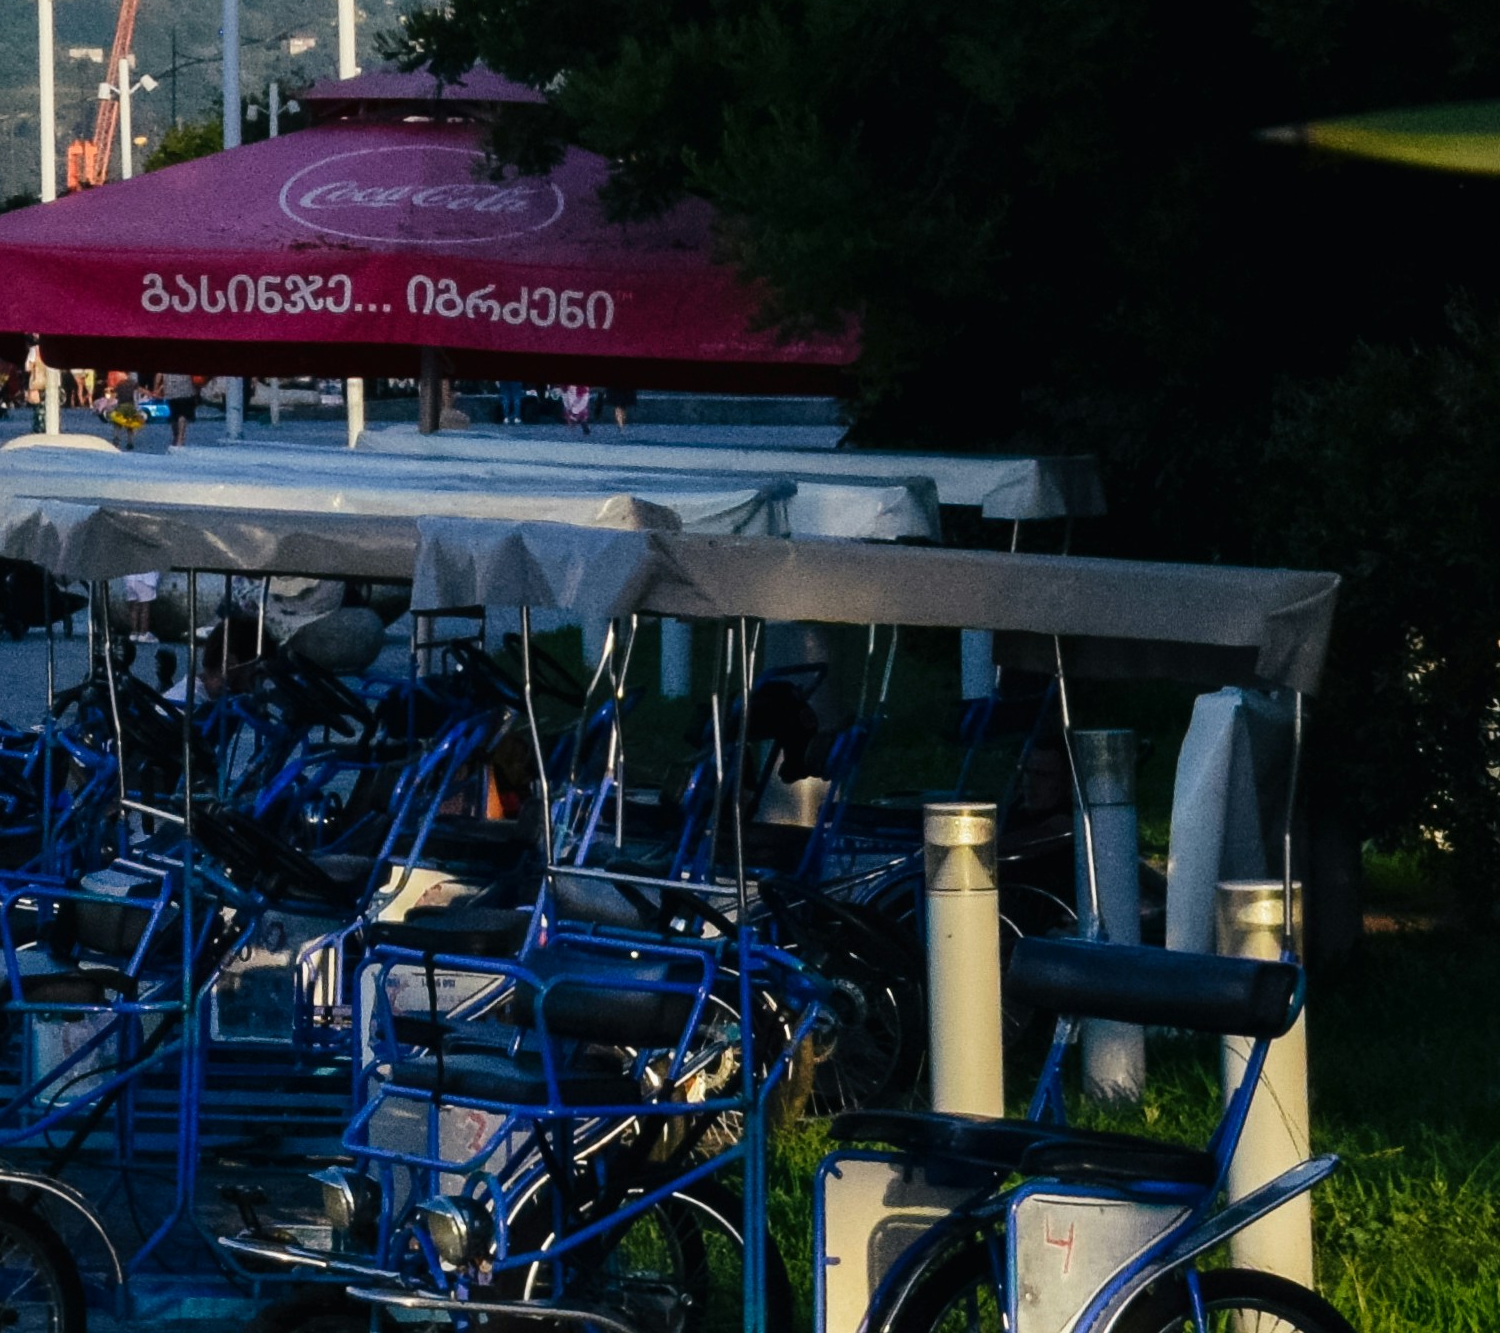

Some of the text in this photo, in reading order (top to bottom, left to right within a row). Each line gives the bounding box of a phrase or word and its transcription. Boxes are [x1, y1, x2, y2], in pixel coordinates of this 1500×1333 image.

[141, 273, 390, 314] გასინჯე...
[407, 275, 614, 330] იგრძენი
[1045, 1214, 1075, 1275] 4
